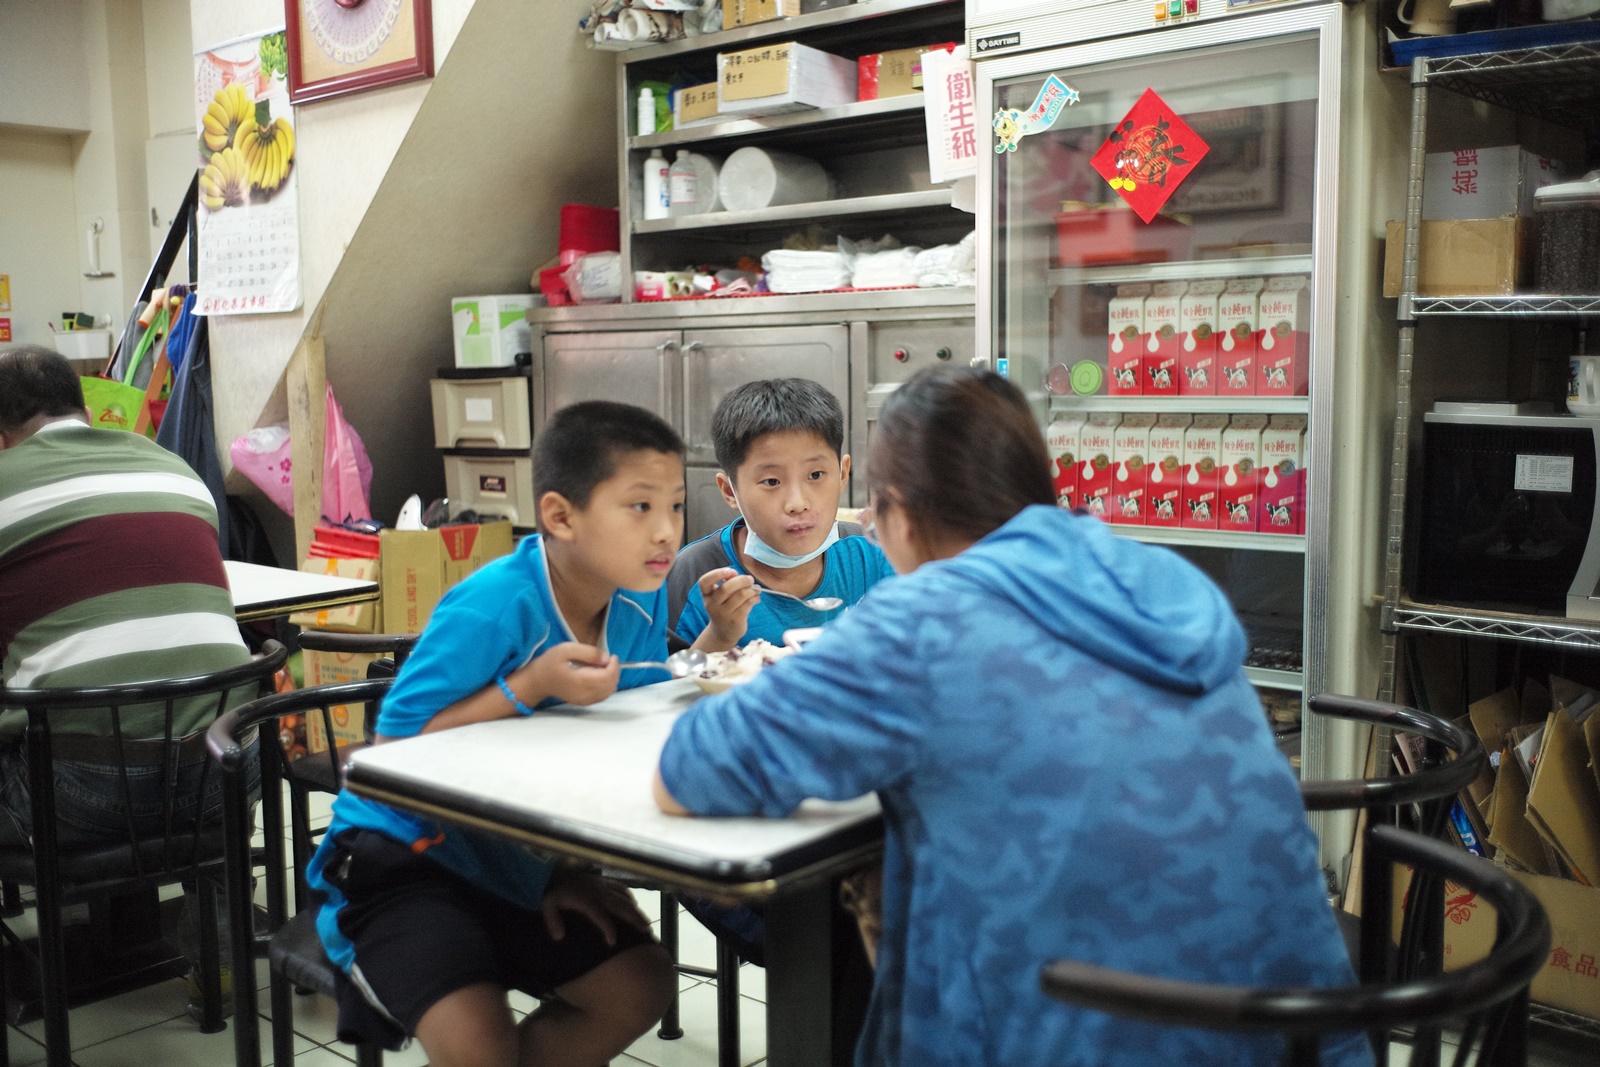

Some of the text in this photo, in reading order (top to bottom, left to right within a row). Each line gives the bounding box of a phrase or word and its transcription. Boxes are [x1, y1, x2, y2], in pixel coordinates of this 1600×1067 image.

[988, 36, 1020, 48] DAYTIME
[946, 70, 977, 159] 衛生紙
[406, 586, 417, 603] AND
[1550, 945, 1599, 978] 食品
